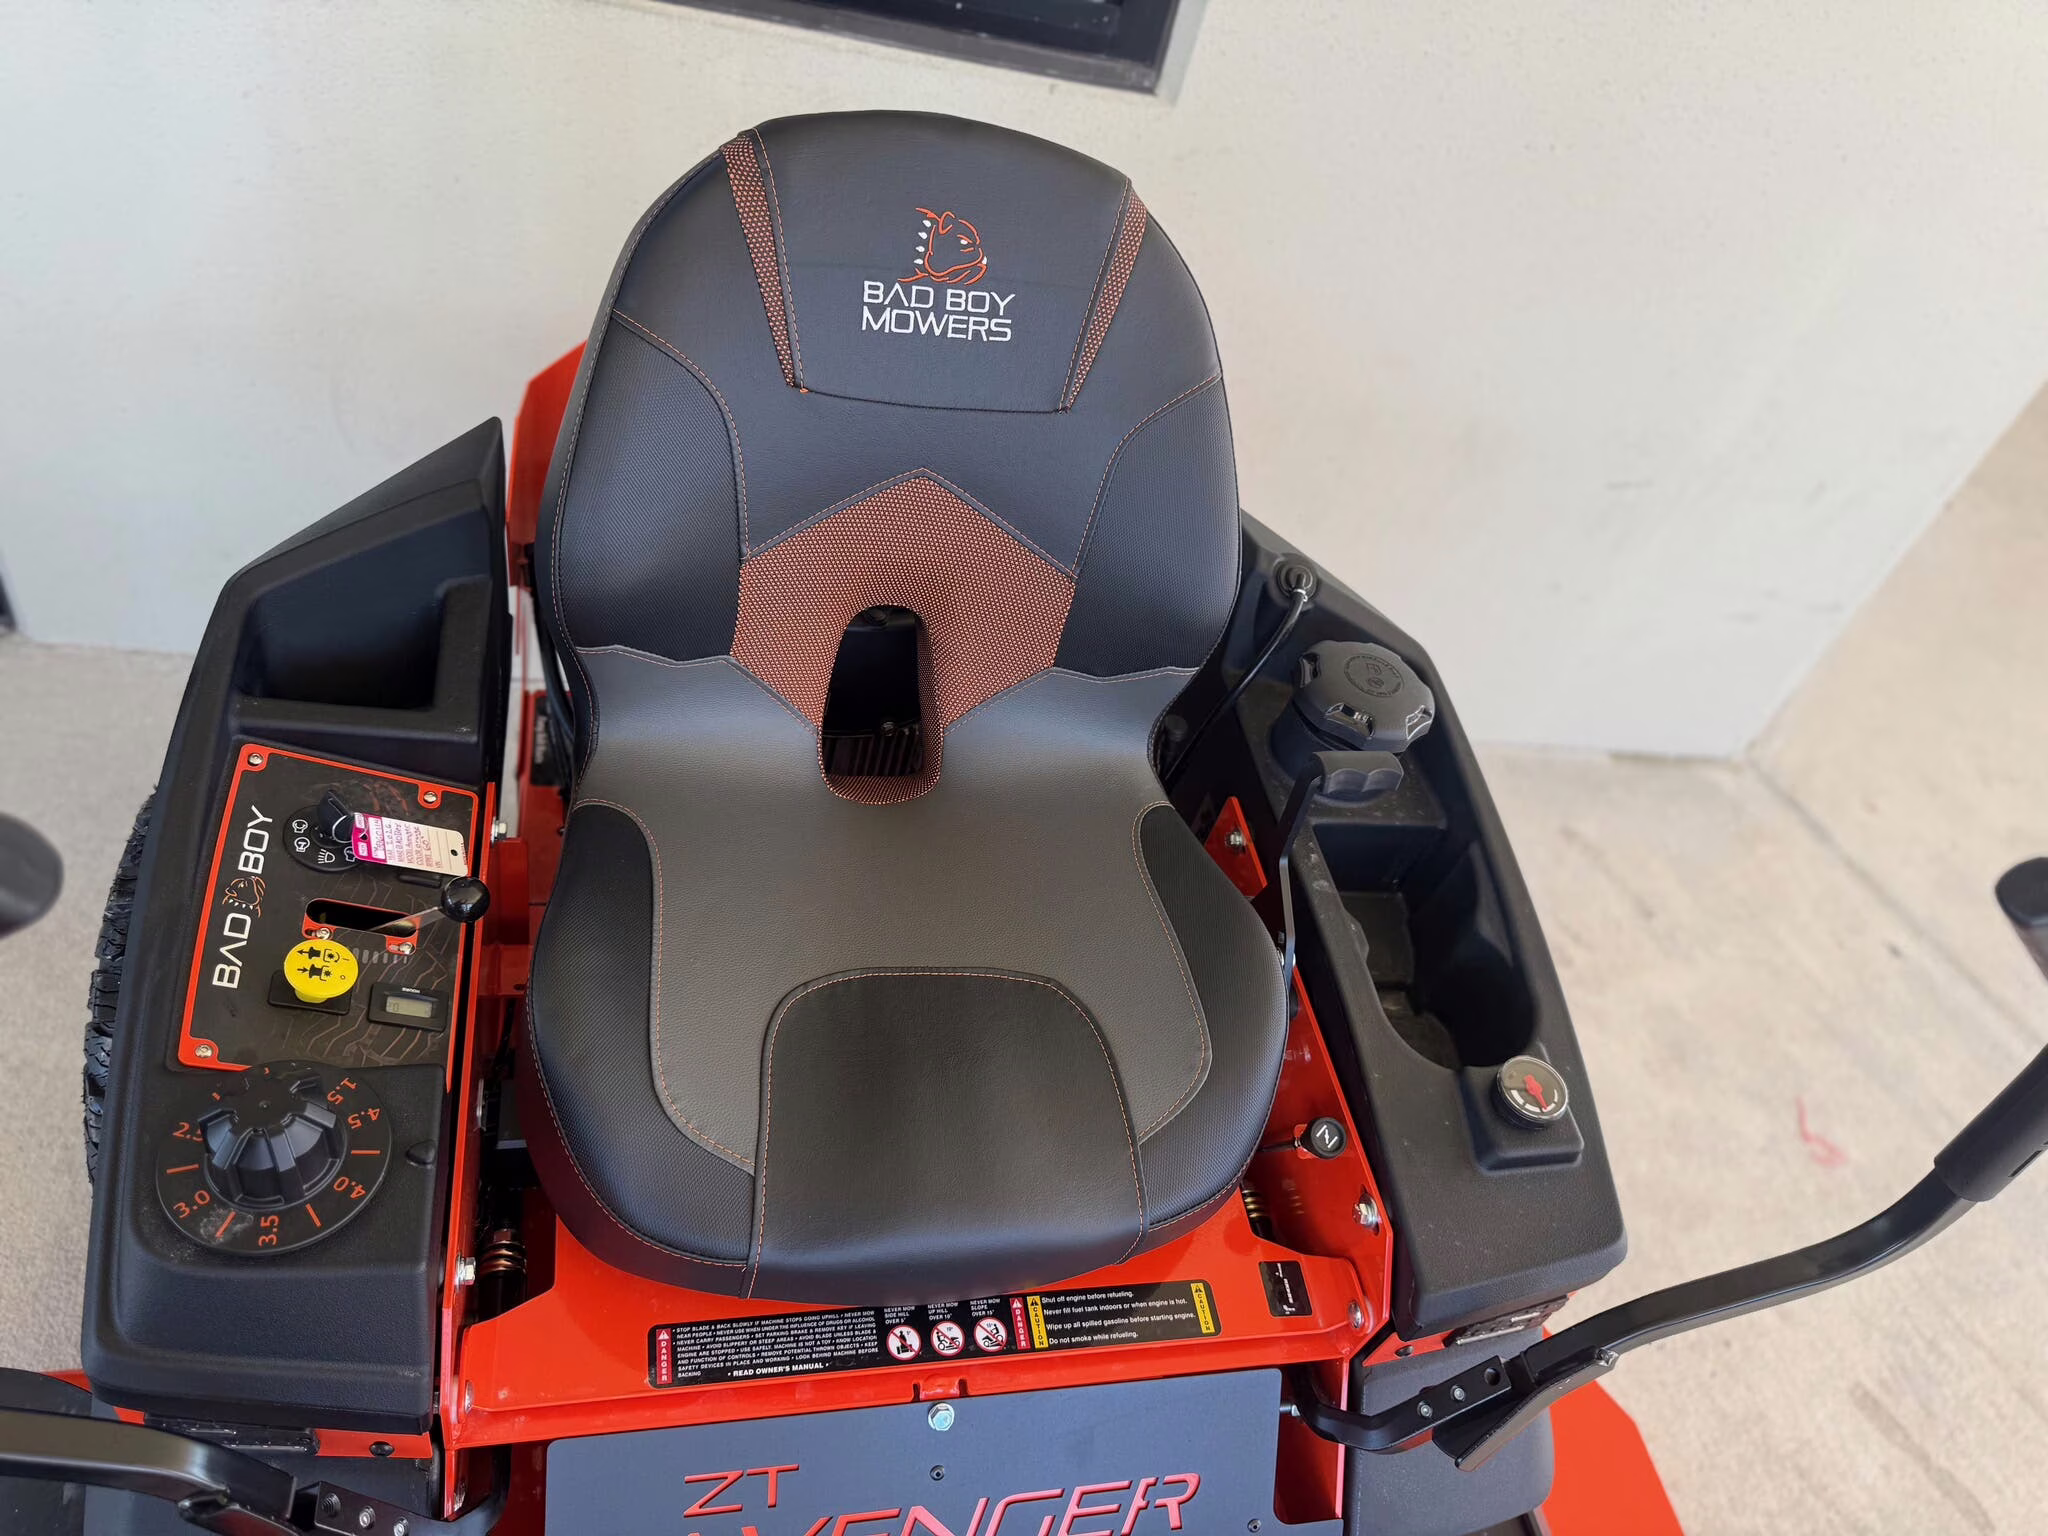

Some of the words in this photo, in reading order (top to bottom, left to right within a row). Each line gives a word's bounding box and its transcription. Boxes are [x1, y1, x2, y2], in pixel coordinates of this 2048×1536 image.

[863, 280, 934, 309] BAD
[946, 288, 1016, 316] BOY
[861, 306, 1012, 342] MOWERS
[212, 912, 252, 988] BAD
[238, 804, 273, 875] BOY
[327, 1078, 358, 1104] 1.5
[348, 1107, 381, 1129] 4.5
[172, 1190, 210, 1219] 3.0
[333, 1176, 366, 1199] 4.0
[258, 1215, 280, 1246] 3.5
[1016, 1310, 1026, 1347] DANGER
[1033, 1307, 1044, 1346] CAUTION
[1104, 1318, 1128, 1326] gasoline
[1198, 1294, 1210, 1330] CAUTION
[756, 1366, 790, 1374] OWNER'S
[792, 1362, 824, 1371] MANUAL
[684, 1464, 800, 1518] ZT
[687, 1473, 1200, 1536] ENGER
